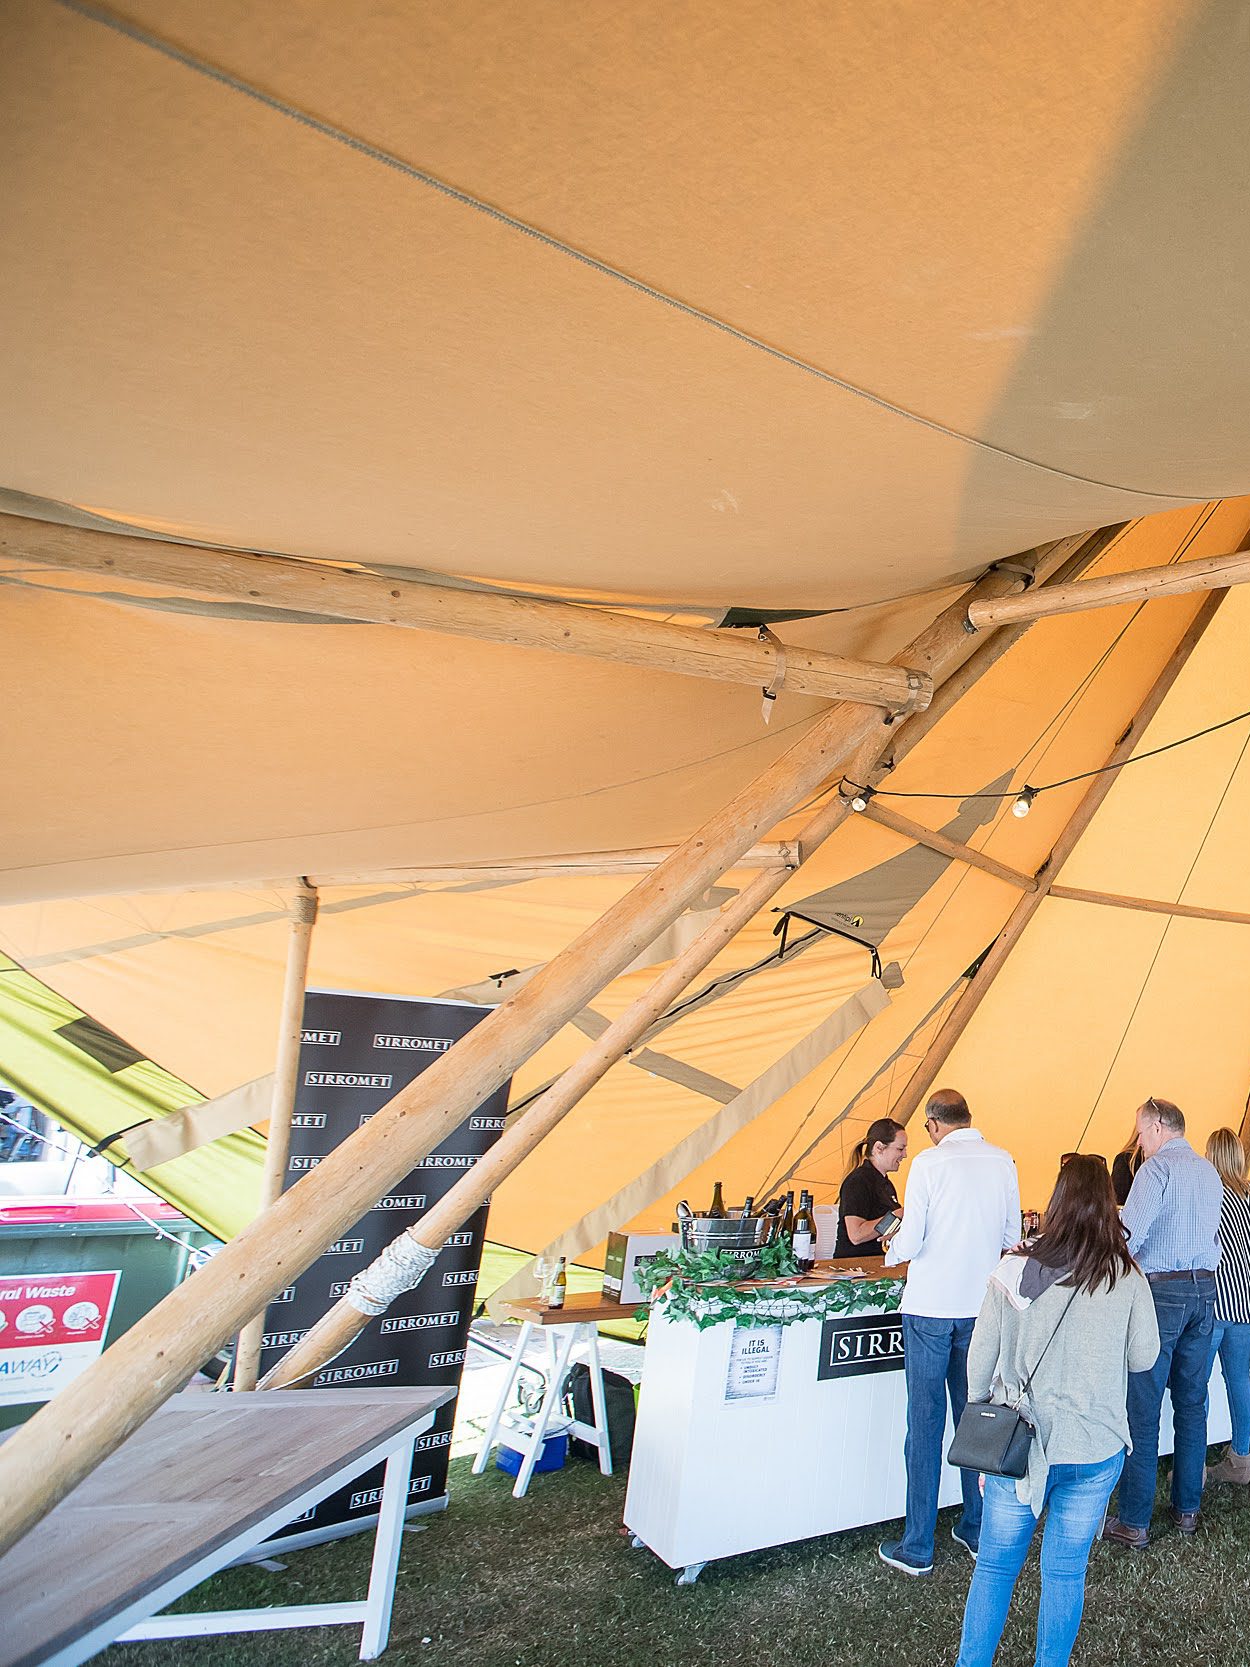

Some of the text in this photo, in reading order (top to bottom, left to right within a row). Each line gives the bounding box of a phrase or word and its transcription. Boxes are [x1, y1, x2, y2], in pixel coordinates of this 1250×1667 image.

[376, 1036, 450, 1050] SIRROMET
[308, 1073, 389, 1087] SIRROMET
[472, 1119, 506, 1128] SIRR
[420, 1157, 478, 1167] IRROME
[372, 1197, 423, 1208] ROMET
[446, 1272, 478, 1284] SIRR
[25, 1285, 76, 1299] Waste
[383, 1314, 456, 1332] SIRROMET
[262, 1331, 308, 1347] SIRR
[837, 1331, 905, 1360] SIRR
[742, 1346, 770, 1355] ILLEGAL
[0, 1357, 55, 1374] AWAY
[431, 1352, 466, 1367] SIRR
[318, 1363, 396, 1384] SIRROMET
[418, 1433, 452, 1448] SIRR
